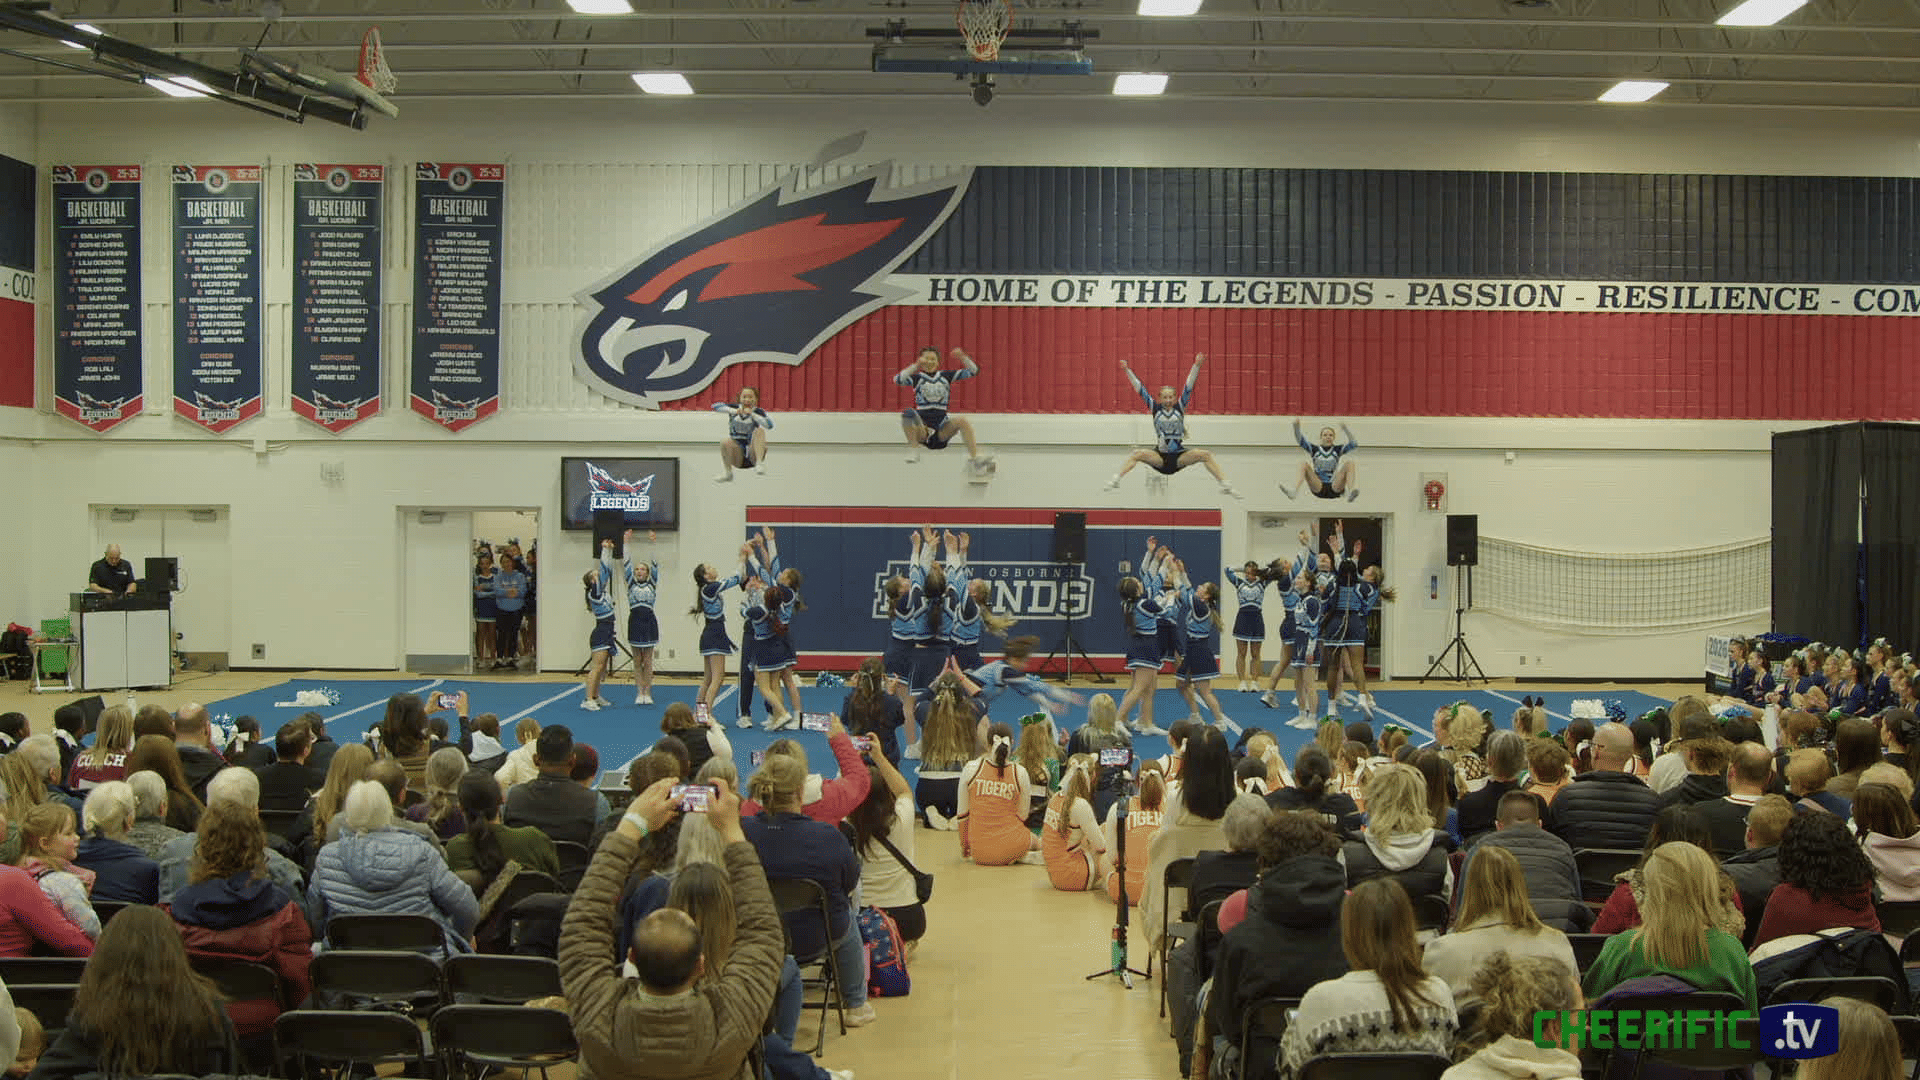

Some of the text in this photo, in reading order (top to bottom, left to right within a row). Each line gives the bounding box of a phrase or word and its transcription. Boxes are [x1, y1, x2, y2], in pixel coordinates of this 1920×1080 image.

[480, 167, 501, 177] 25-26
[67, 201, 126, 217] BASKETBALL
[187, 201, 245, 217] BASKETBALL
[308, 200, 367, 216] BASKETBALL
[430, 199, 488, 216] BASKETBALL
[13, 273, 35, 300] CO
[928, 278, 1039, 302] HOME
[1051, 279, 1099, 303] OF
[1110, 280, 1187, 304] THE
[1198, 280, 1374, 305] LEGENDS
[1406, 282, 1565, 307] PASSION
[1596, 285, 1820, 311] RESILIENCE
[593, 497, 648, 509] LEGENDS
[77, 752, 127, 768] COCH
[975, 778, 1016, 801] TIGERS
